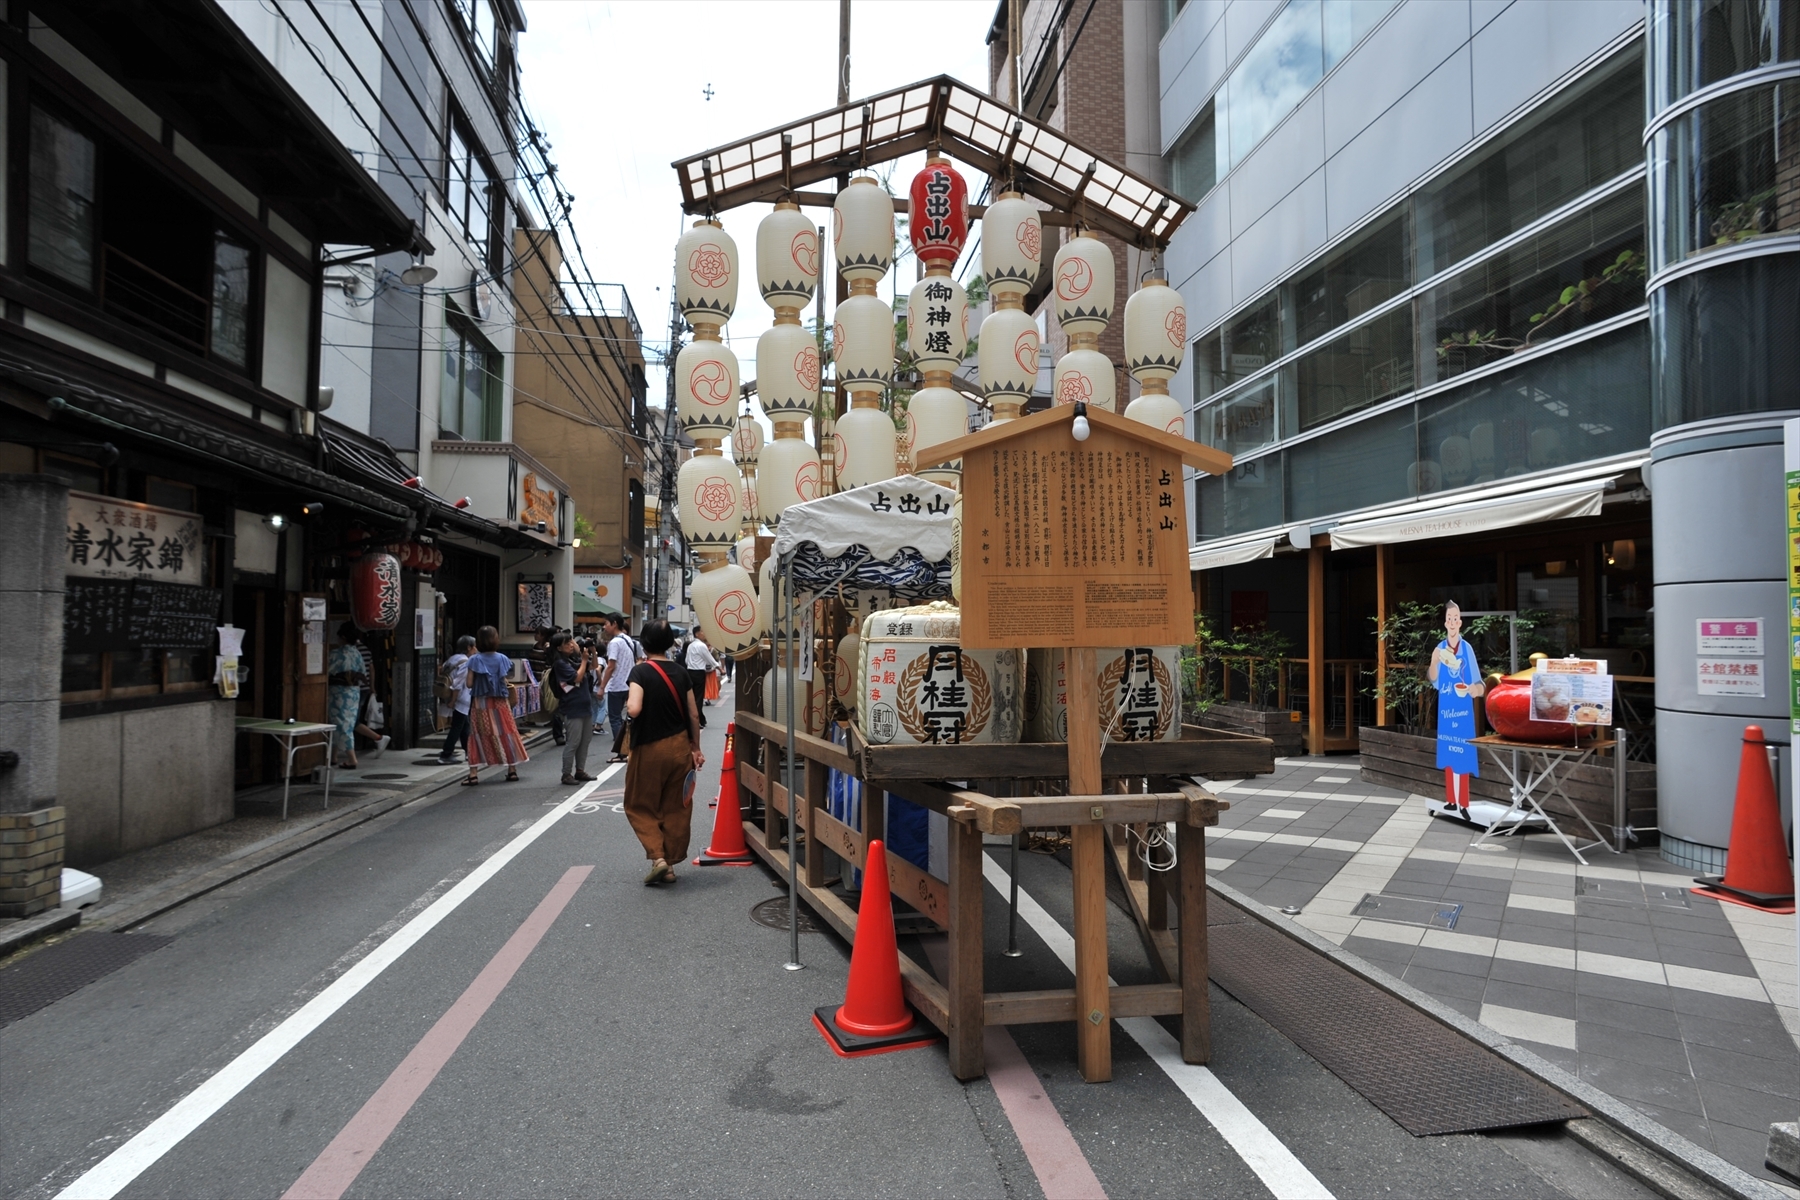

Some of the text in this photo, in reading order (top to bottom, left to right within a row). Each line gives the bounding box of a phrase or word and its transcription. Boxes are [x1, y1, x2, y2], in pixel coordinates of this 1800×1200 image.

[925, 170, 952, 242] 占出山
[925, 282, 953, 355] 御神燈
[869, 491, 950, 515] 占出山
[1158, 469, 1174, 531] 占出山
[95, 505, 158, 532] 大衆酒場
[1400, 526, 1423, 536] MLESNA
[1465, 519, 1486, 527] KYOTO
[66, 522, 185, 575] 清水家錦
[982, 528, 990, 565] 京都市
[374, 559, 400, 625] 清水家
[886, 622, 913, 636] 登録
[1709, 624, 1748, 634] 警告
[1699, 663, 1759, 675] 全館禁煙
[921, 646, 969, 745] 月桂冠
[1119, 648, 1160, 742] 月桂冠
[1440, 708, 1469, 719] Welcome
[1448, 745, 1464, 754] KYOTO
